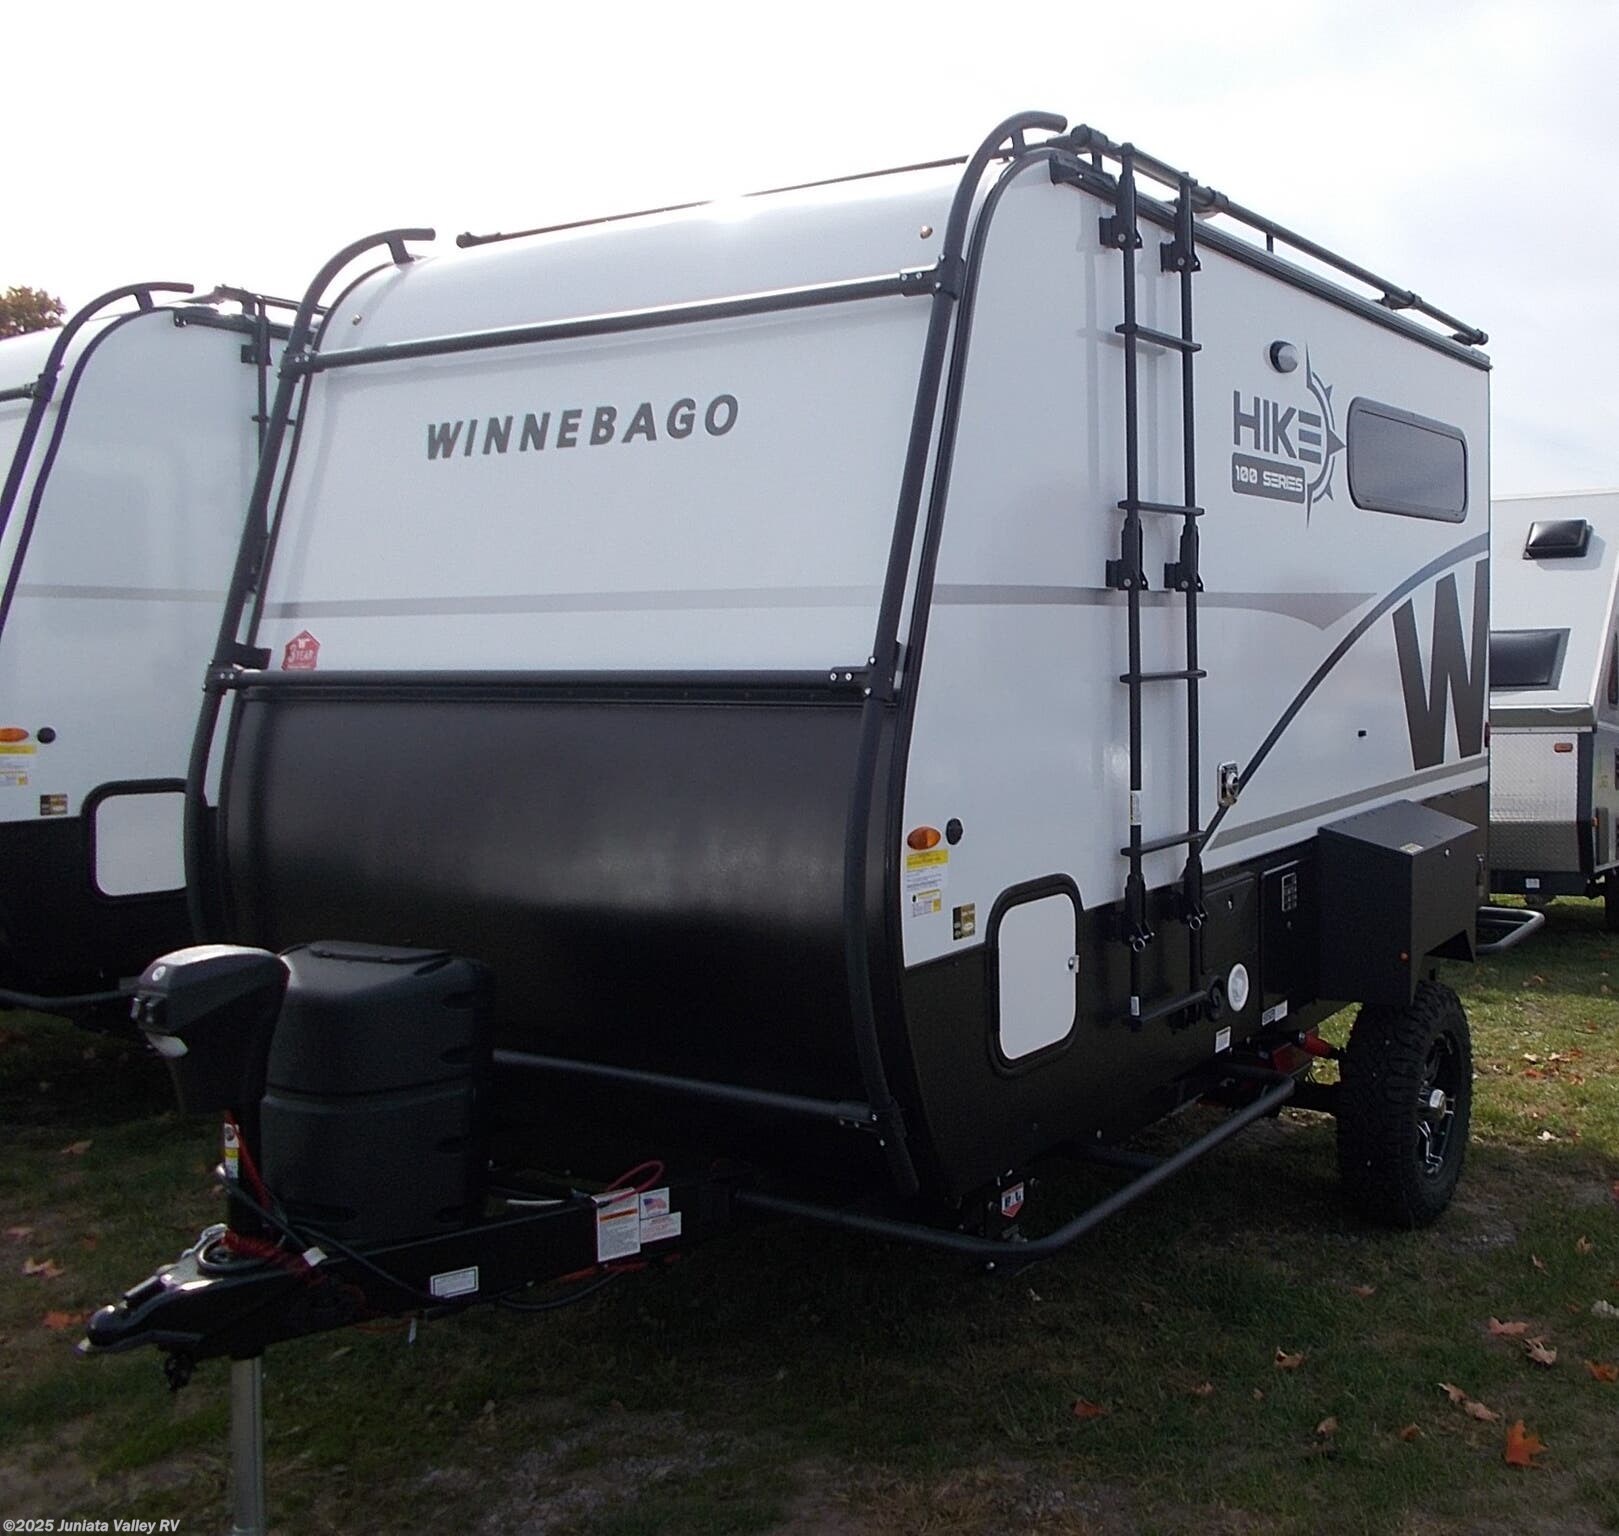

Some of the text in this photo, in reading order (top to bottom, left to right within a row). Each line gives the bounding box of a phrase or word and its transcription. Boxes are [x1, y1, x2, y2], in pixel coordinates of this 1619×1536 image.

[426, 393, 739, 460] WINNEBAGO
[1233, 390, 1322, 465] HIKE
[1235, 465, 1304, 492] 100 SERIES
